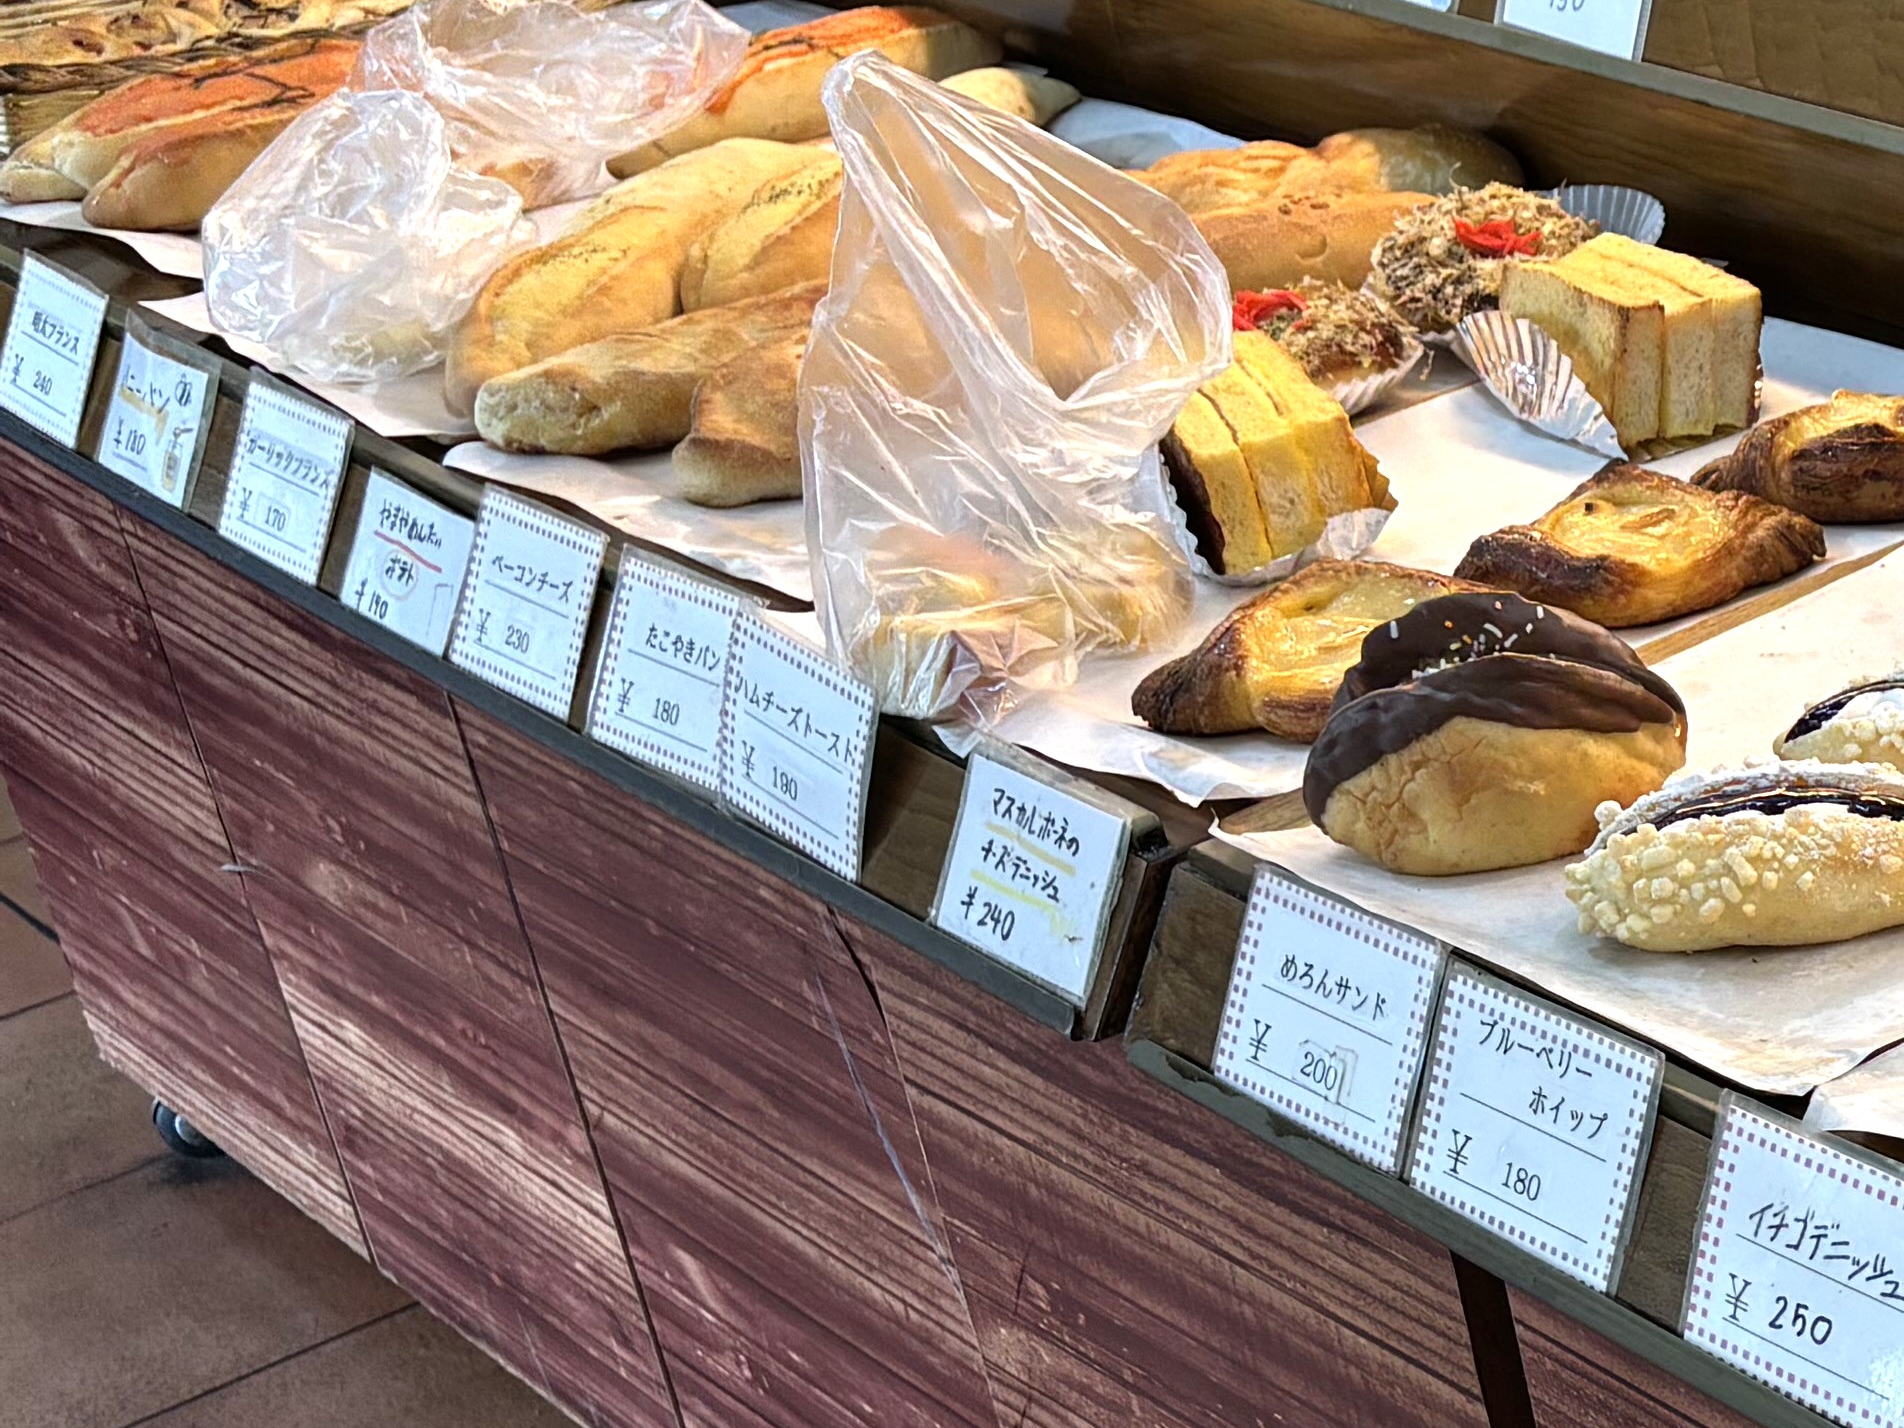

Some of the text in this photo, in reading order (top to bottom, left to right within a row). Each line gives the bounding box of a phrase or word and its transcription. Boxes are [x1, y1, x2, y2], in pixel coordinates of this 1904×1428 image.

[33, 370, 52, 396] 240
[248, 437, 330, 489] ガーリックフランス
[264, 504, 286, 532] 170
[492, 555, 574, 605] ベーコンチーズ
[504, 623, 530, 653] 230
[646, 624, 721, 673] たこやきパン
[654, 697, 680, 726] 180
[736, 675, 853, 760] ハムチーズトースト
[993, 788, 1080, 857] マスカルポーネの
[1280, 954, 1390, 1021] めろんサンド
[1300, 1052, 1338, 1091] 200
[1479, 1019, 1593, 1080] ブルーベリー
[1529, 1086, 1609, 1140] ホイップ
[1500, 1162, 1541, 1202] 180
[1768, 1295, 1833, 1346] 250
